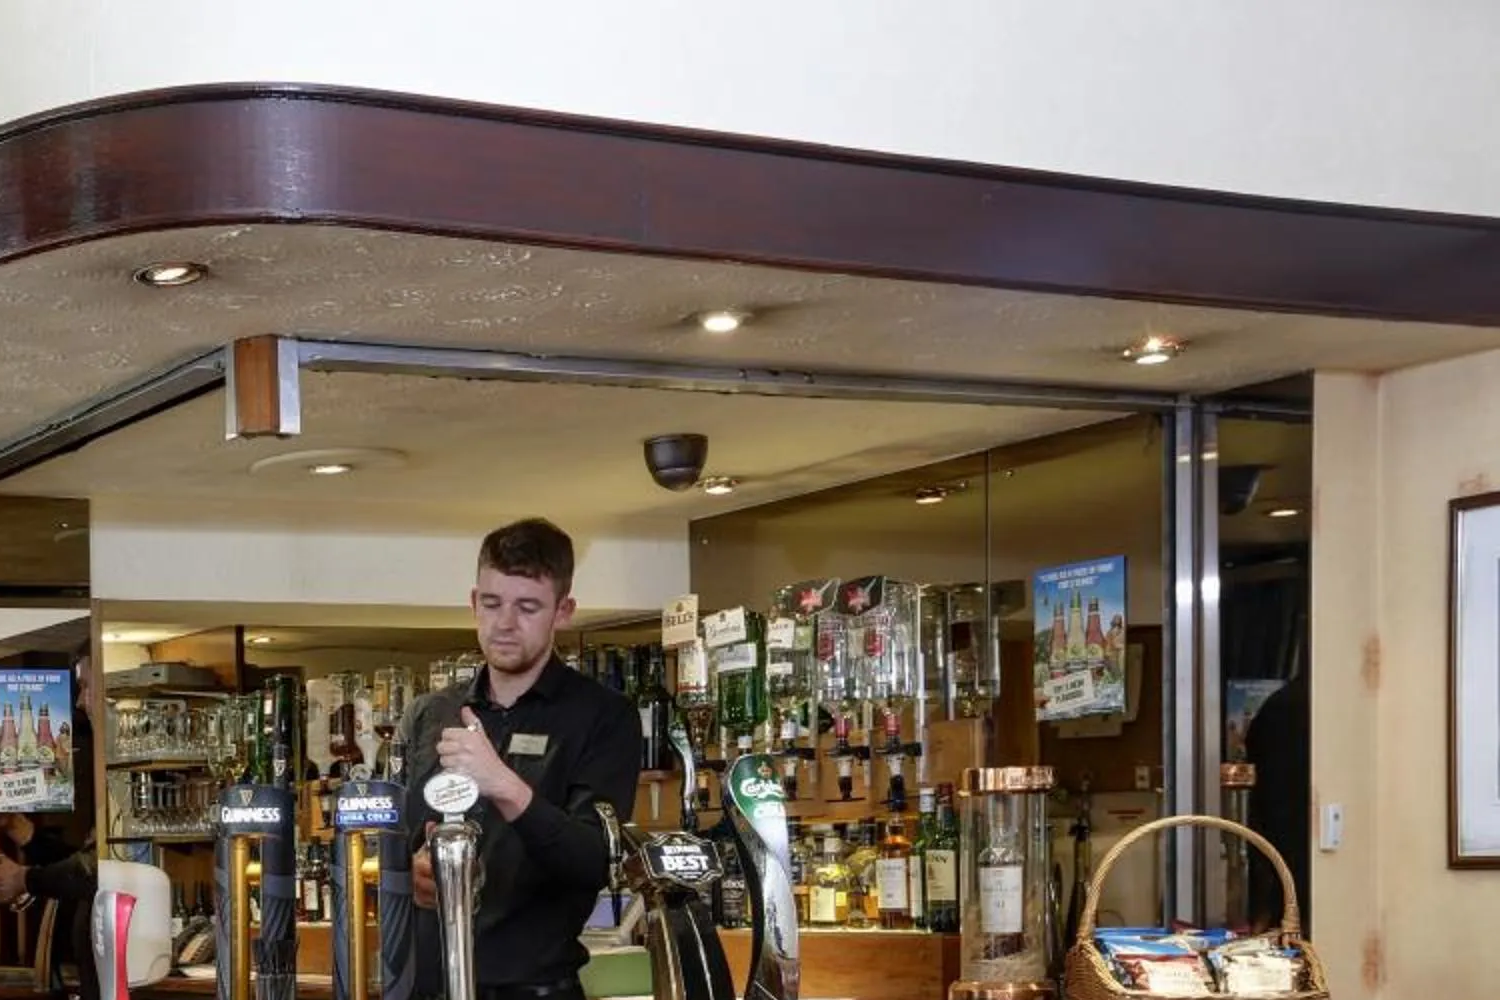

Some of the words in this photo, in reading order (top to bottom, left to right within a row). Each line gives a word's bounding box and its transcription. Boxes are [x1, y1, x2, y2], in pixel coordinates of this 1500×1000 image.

[338, 796, 393, 811] GUINNESS
[221, 807, 281, 823] GUINNESS
[660, 855, 709, 871] BEST
